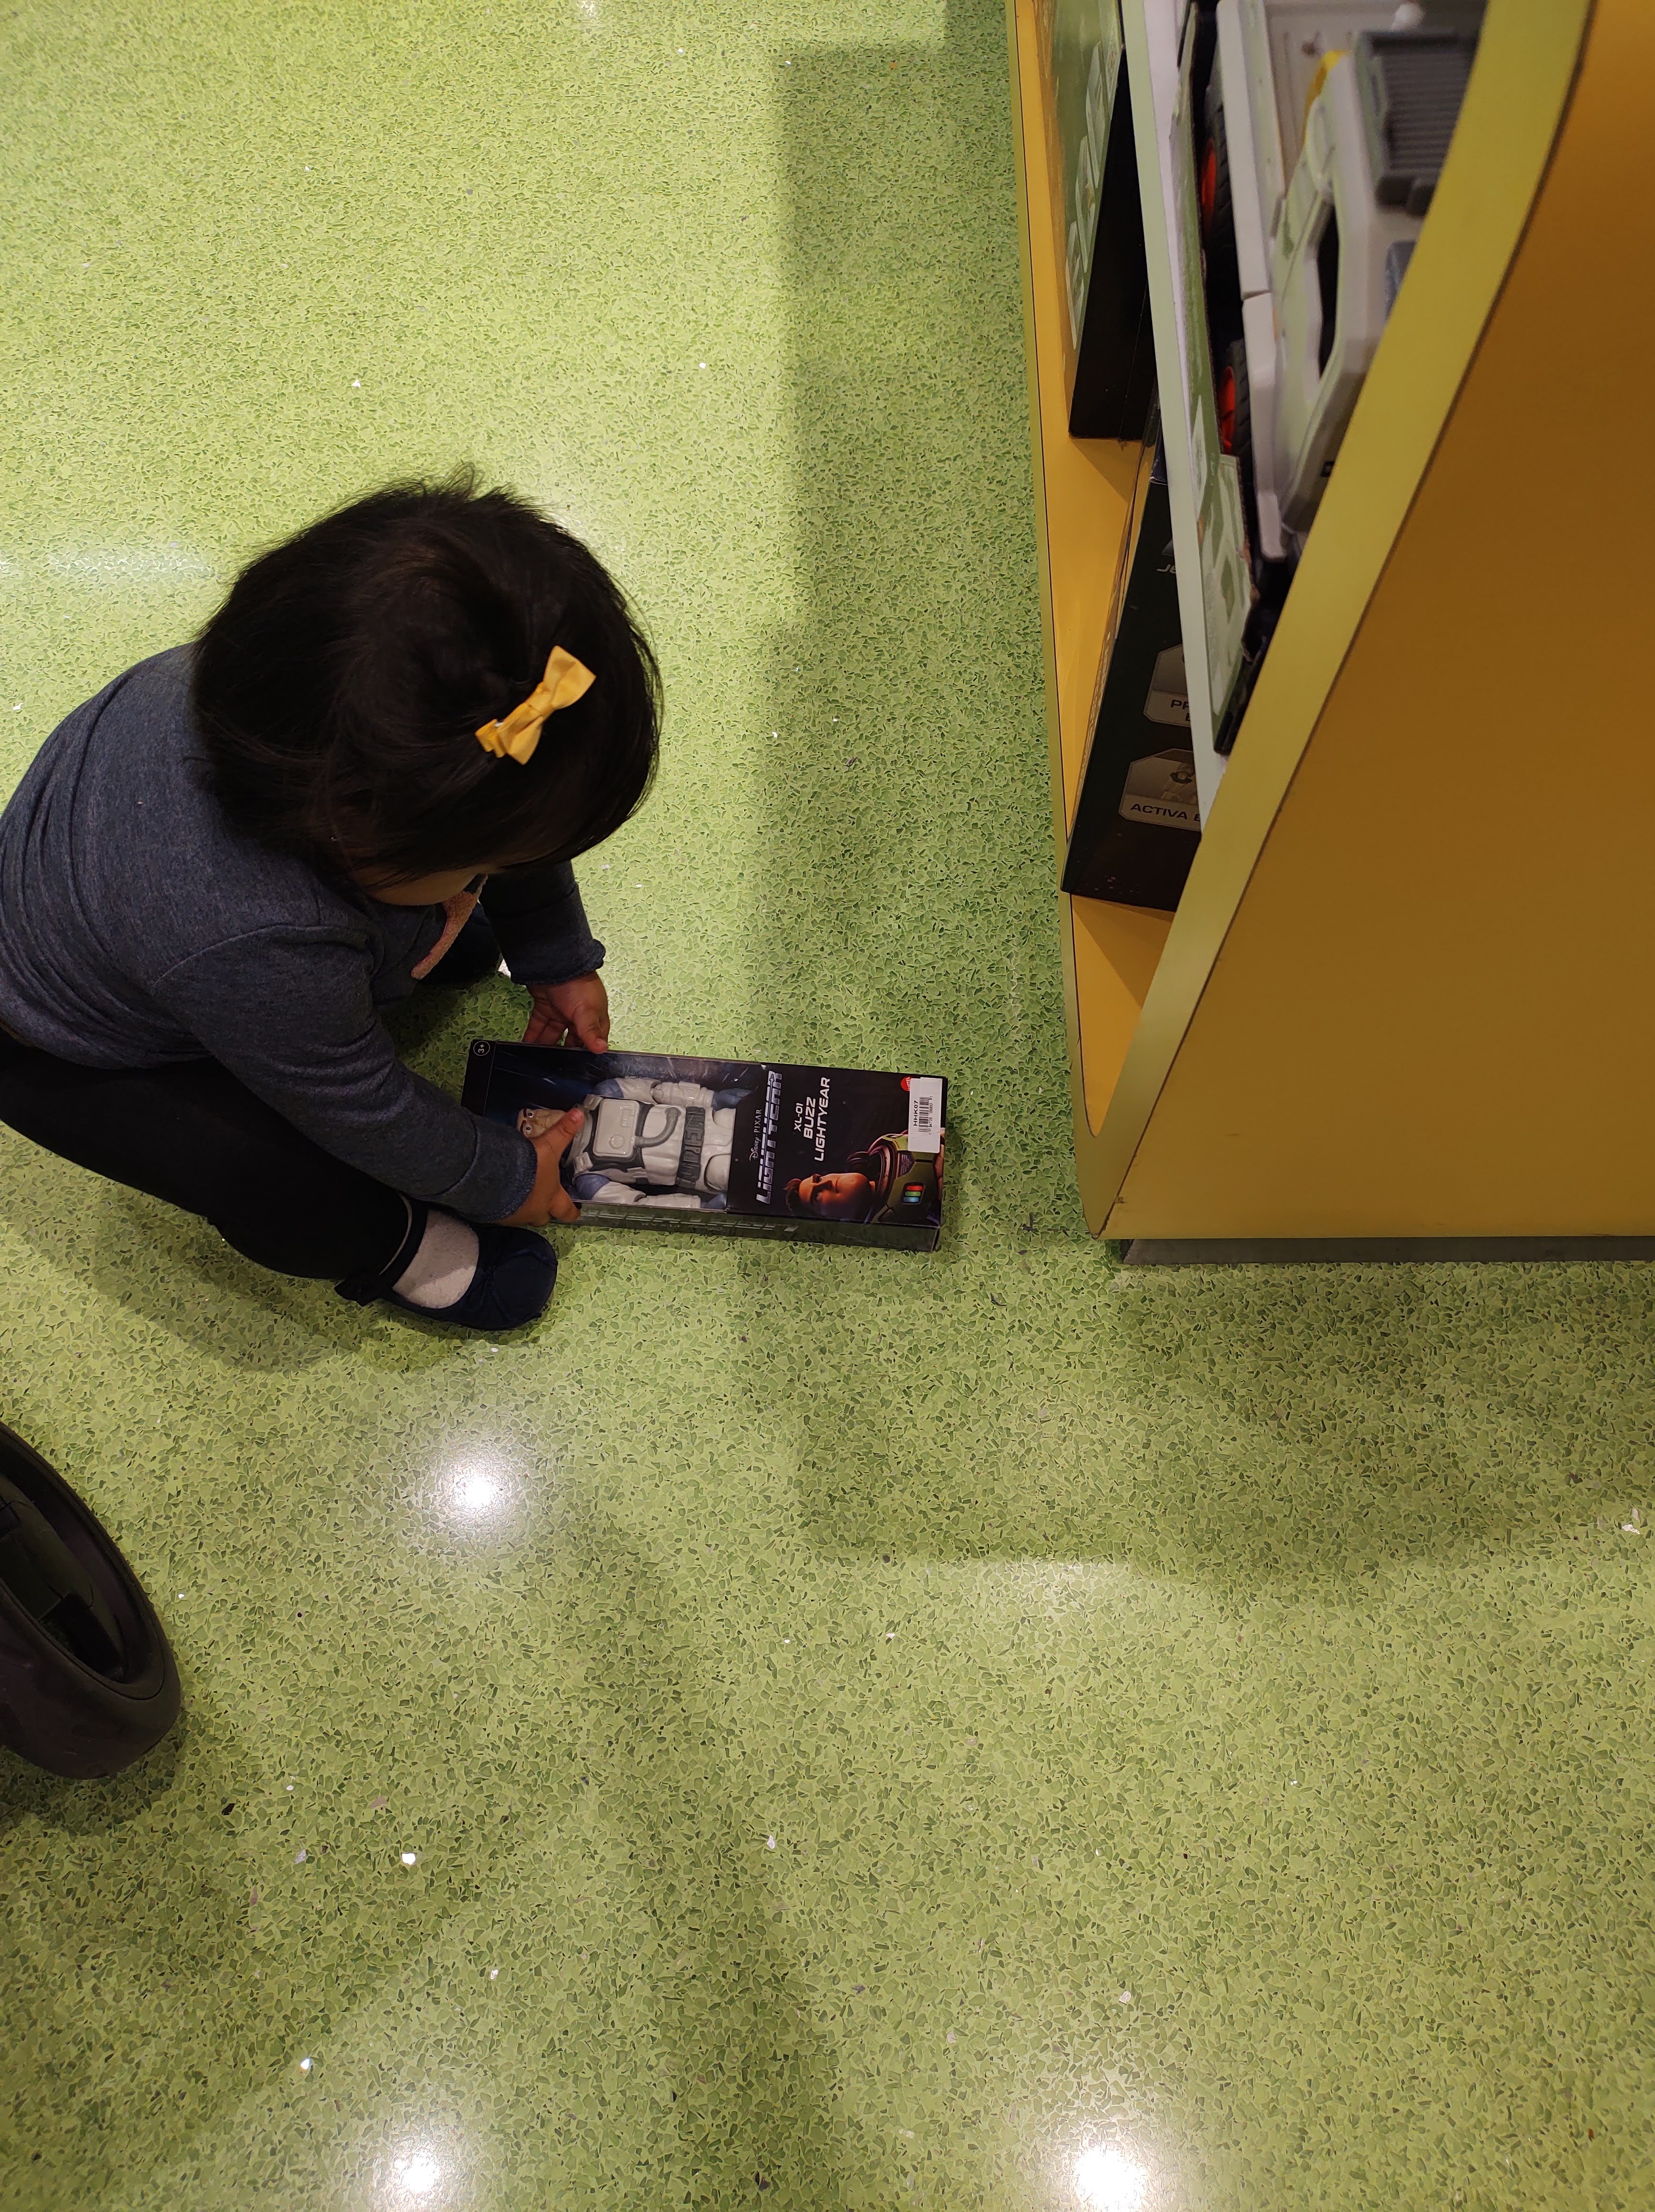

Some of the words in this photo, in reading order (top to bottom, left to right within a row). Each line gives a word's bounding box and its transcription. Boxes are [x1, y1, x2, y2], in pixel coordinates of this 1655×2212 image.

[1130, 803, 1187, 819] ACTIVA
[478, 1044, 484, 1053] 3+
[794, 1103, 803, 1132] XL-01
[804, 1096, 816, 1139] BUZZ
[814, 1077, 830, 1161] LIGHTYEAR
